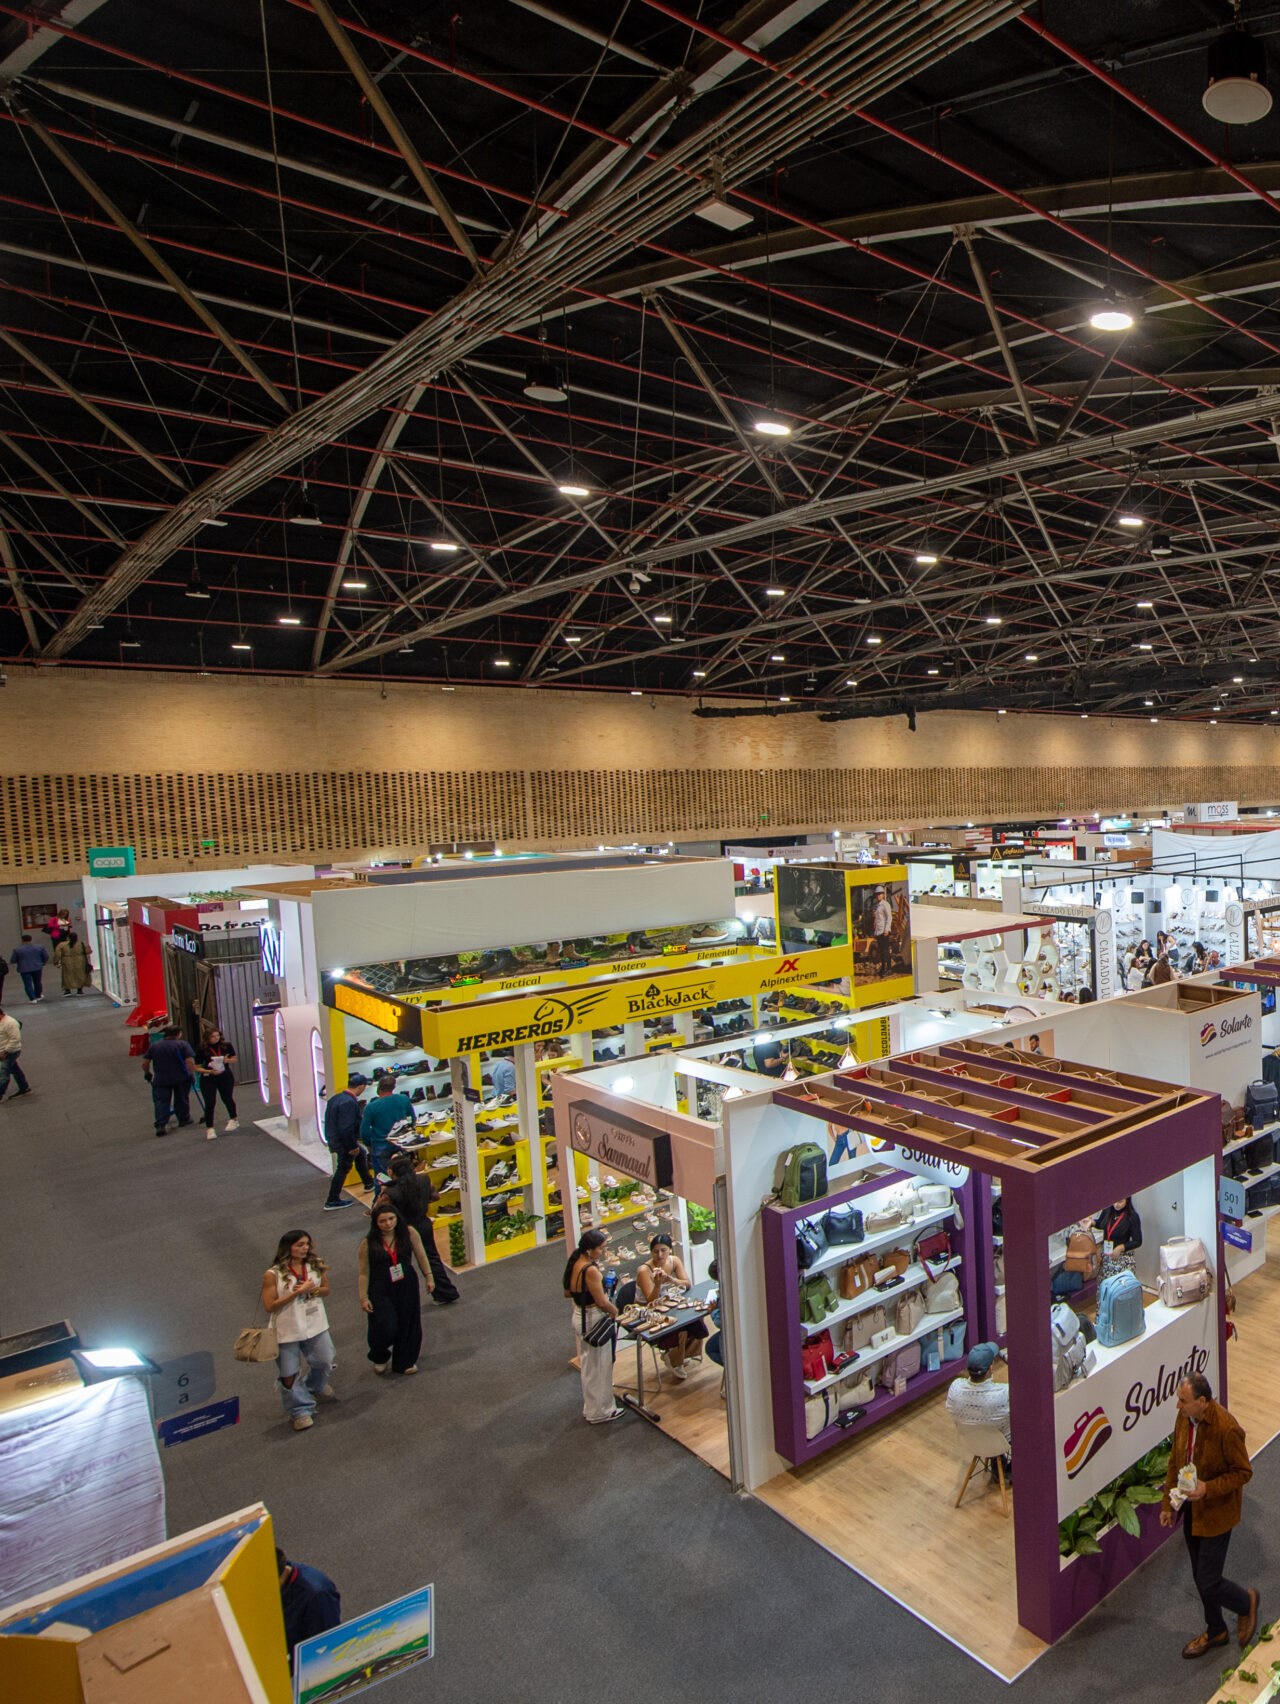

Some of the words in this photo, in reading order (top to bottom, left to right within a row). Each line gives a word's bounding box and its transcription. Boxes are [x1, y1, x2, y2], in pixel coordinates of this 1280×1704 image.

[1207, 804, 1229, 815] moss
[1032, 906, 1065, 914] CALZADO
[1067, 908, 1084, 916] LUPI
[697, 947, 738, 961] Elemental
[612, 961, 647, 973] Motero
[1099, 939, 1110, 985] CALZADO
[499, 975, 542, 990] Tactical
[628, 987, 715, 1013] BlackJack
[1219, 1013, 1252, 1039] Solarte
[456, 1019, 564, 1053] HERREROS
[1224, 1191, 1239, 1205] 501
[177, 1372, 190, 1388] 6
[1122, 1344, 1211, 1432] Solarte
[178, 1392, 189, 1404] a
